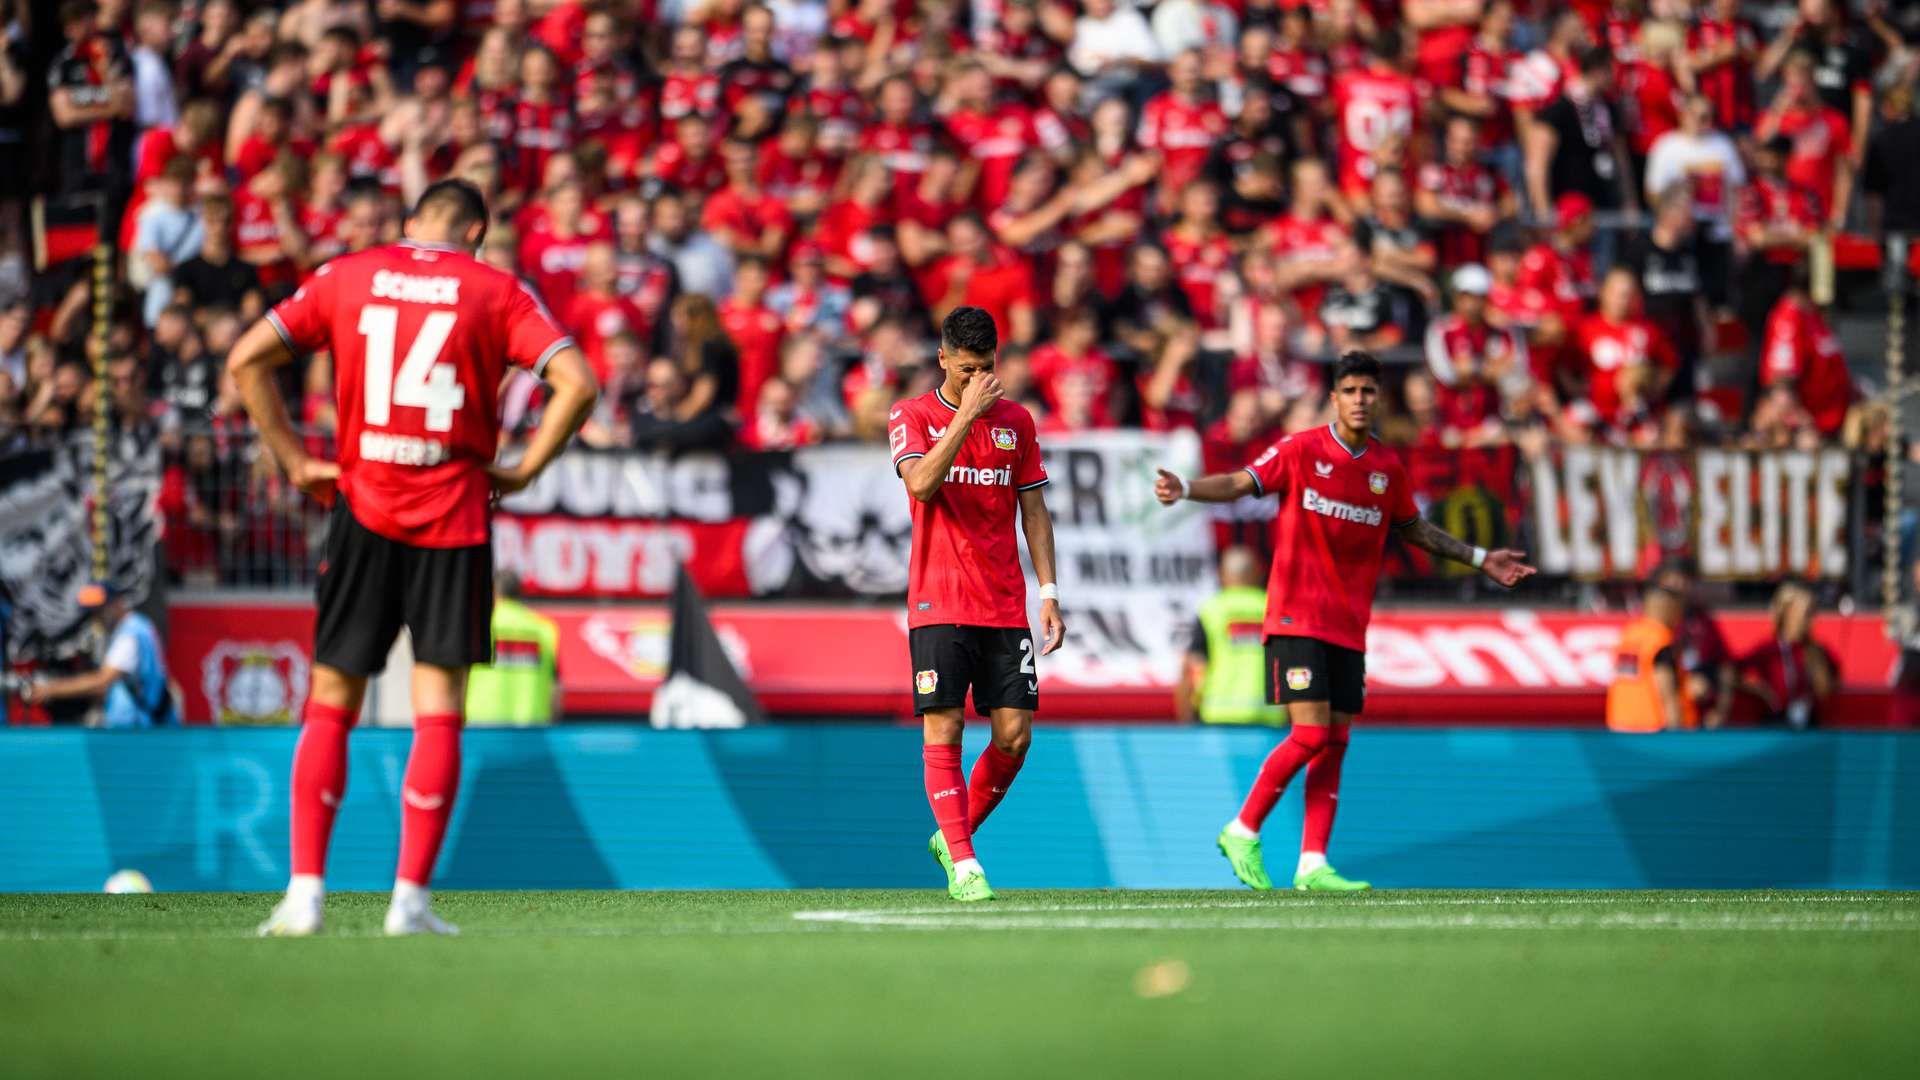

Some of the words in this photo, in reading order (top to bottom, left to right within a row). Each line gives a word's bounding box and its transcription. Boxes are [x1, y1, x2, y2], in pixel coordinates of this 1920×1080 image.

[371, 268, 461, 305] SCHICK
[358, 303, 466, 433] 14
[1302, 486, 1383, 527] Barmenia
[1532, 448, 1640, 574] LEV
[1700, 449, 1850, 576] ELITE
